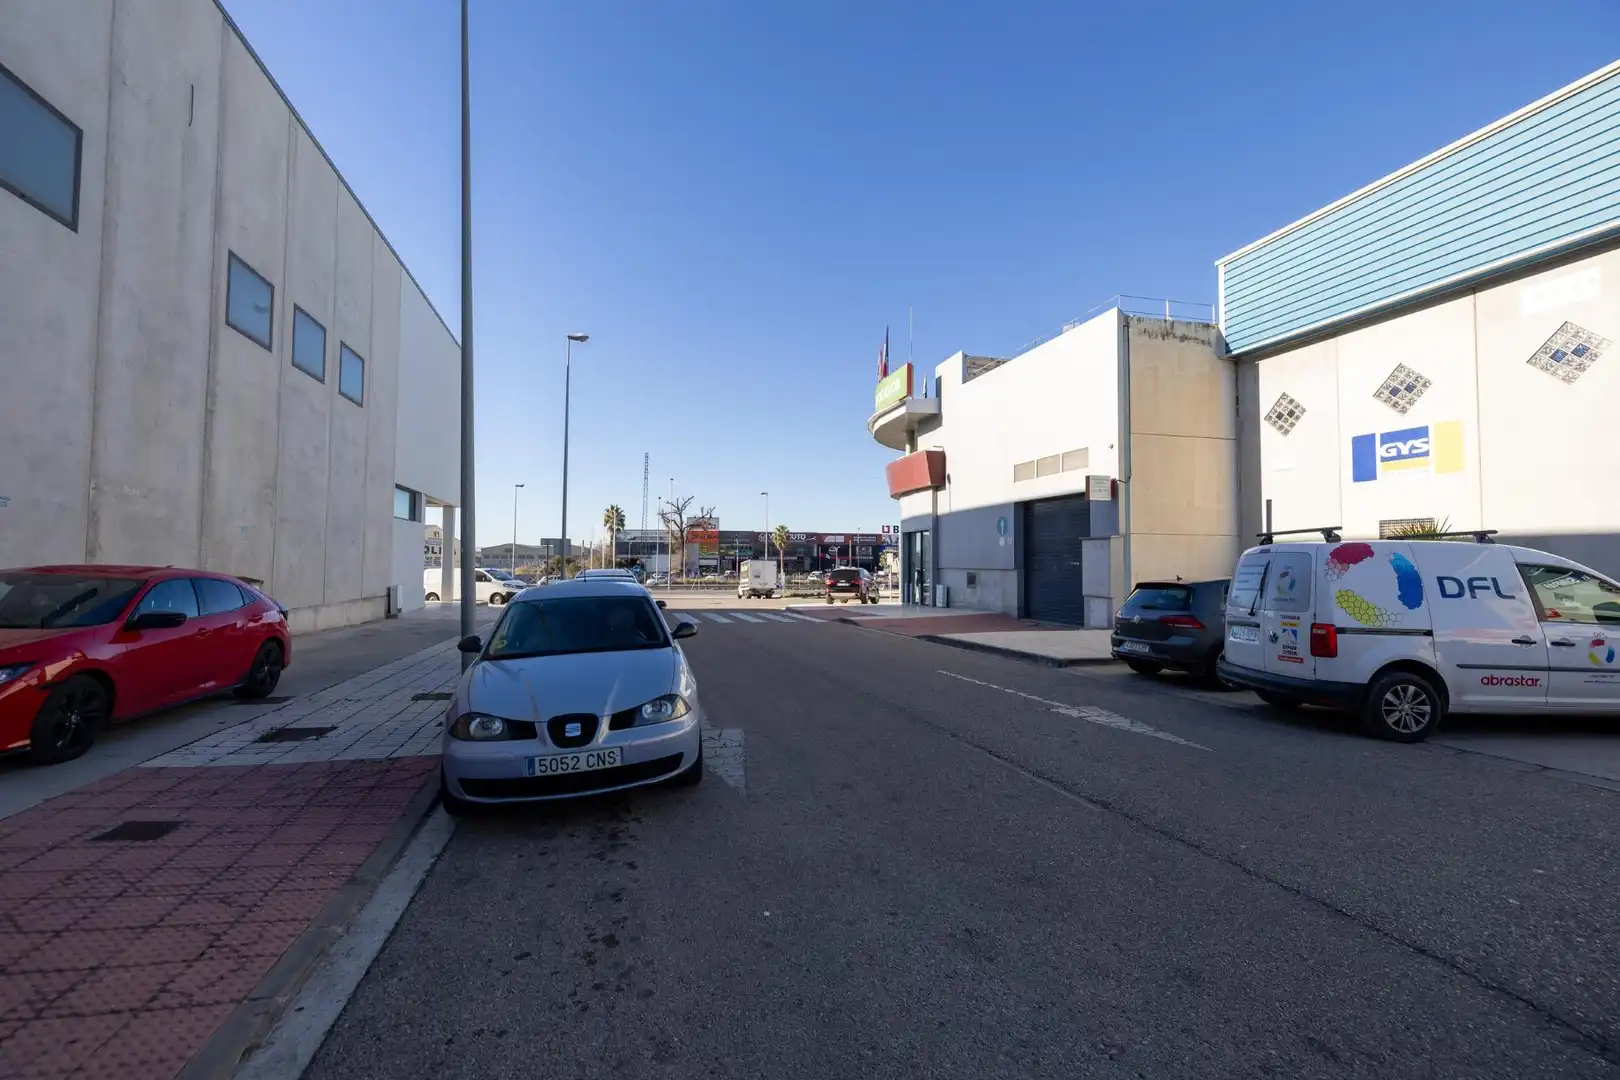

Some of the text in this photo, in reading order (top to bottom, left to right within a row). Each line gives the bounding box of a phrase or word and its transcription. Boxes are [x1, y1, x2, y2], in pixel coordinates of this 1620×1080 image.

[1380, 438, 1429, 457] GYS
[1436, 576, 1516, 600] DFL
[1481, 674, 1542, 687] abrastar.
[538, 750, 617, 774] 5052 CNS
